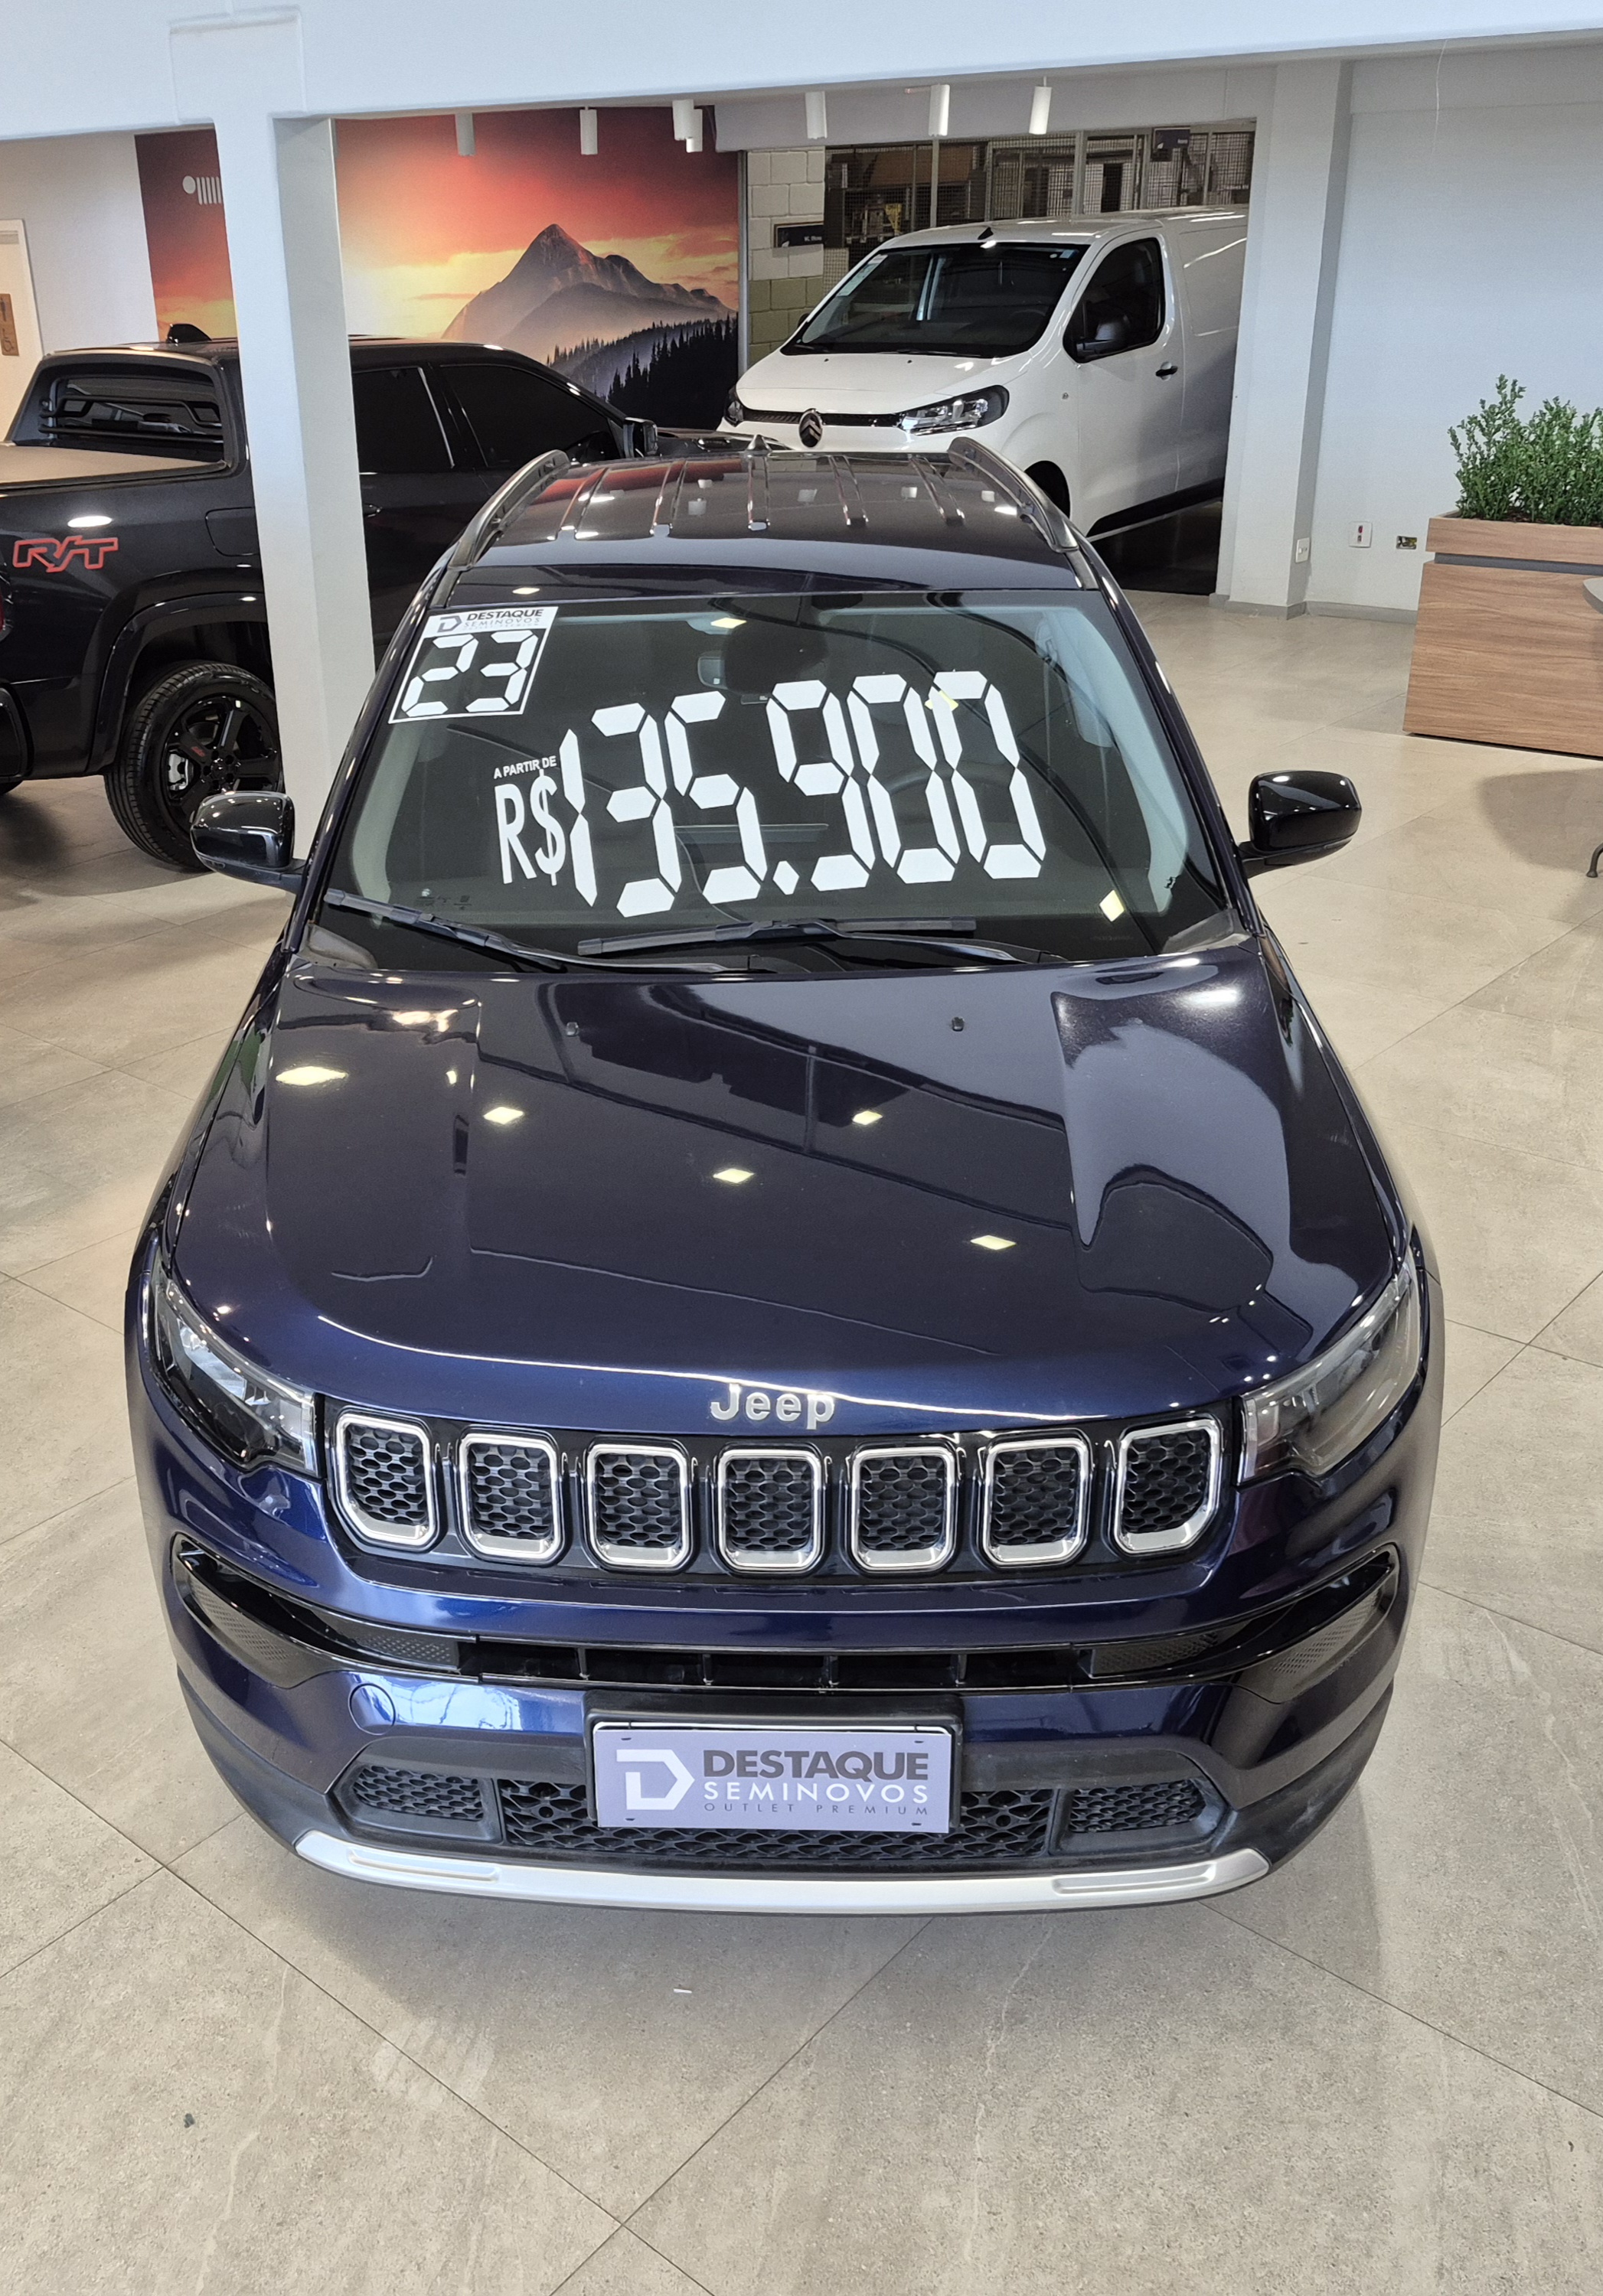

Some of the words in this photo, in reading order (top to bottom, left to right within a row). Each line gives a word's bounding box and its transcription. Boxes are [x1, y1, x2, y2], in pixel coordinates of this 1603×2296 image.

[12, 535, 119, 572] R/T
[465, 617, 540, 628] SEMINOVOS
[467, 609, 544, 621] DESTAQUE
[400, 630, 539, 717] 23
[494, 768, 502, 779] A
[503, 758, 541, 778] PARTIR
[541, 755, 557, 768] DE
[495, 768, 566, 885] R$
[559, 670, 1046, 917] 135.900
[710, 1383, 835, 1430] Jeep
[704, 1750, 929, 1782] DESTAQUE
[704, 1781, 929, 1804] SEMINOVOS
[704, 1802, 794, 1813] OUTLET
[816, 1804, 928, 1815] PREMIUM
